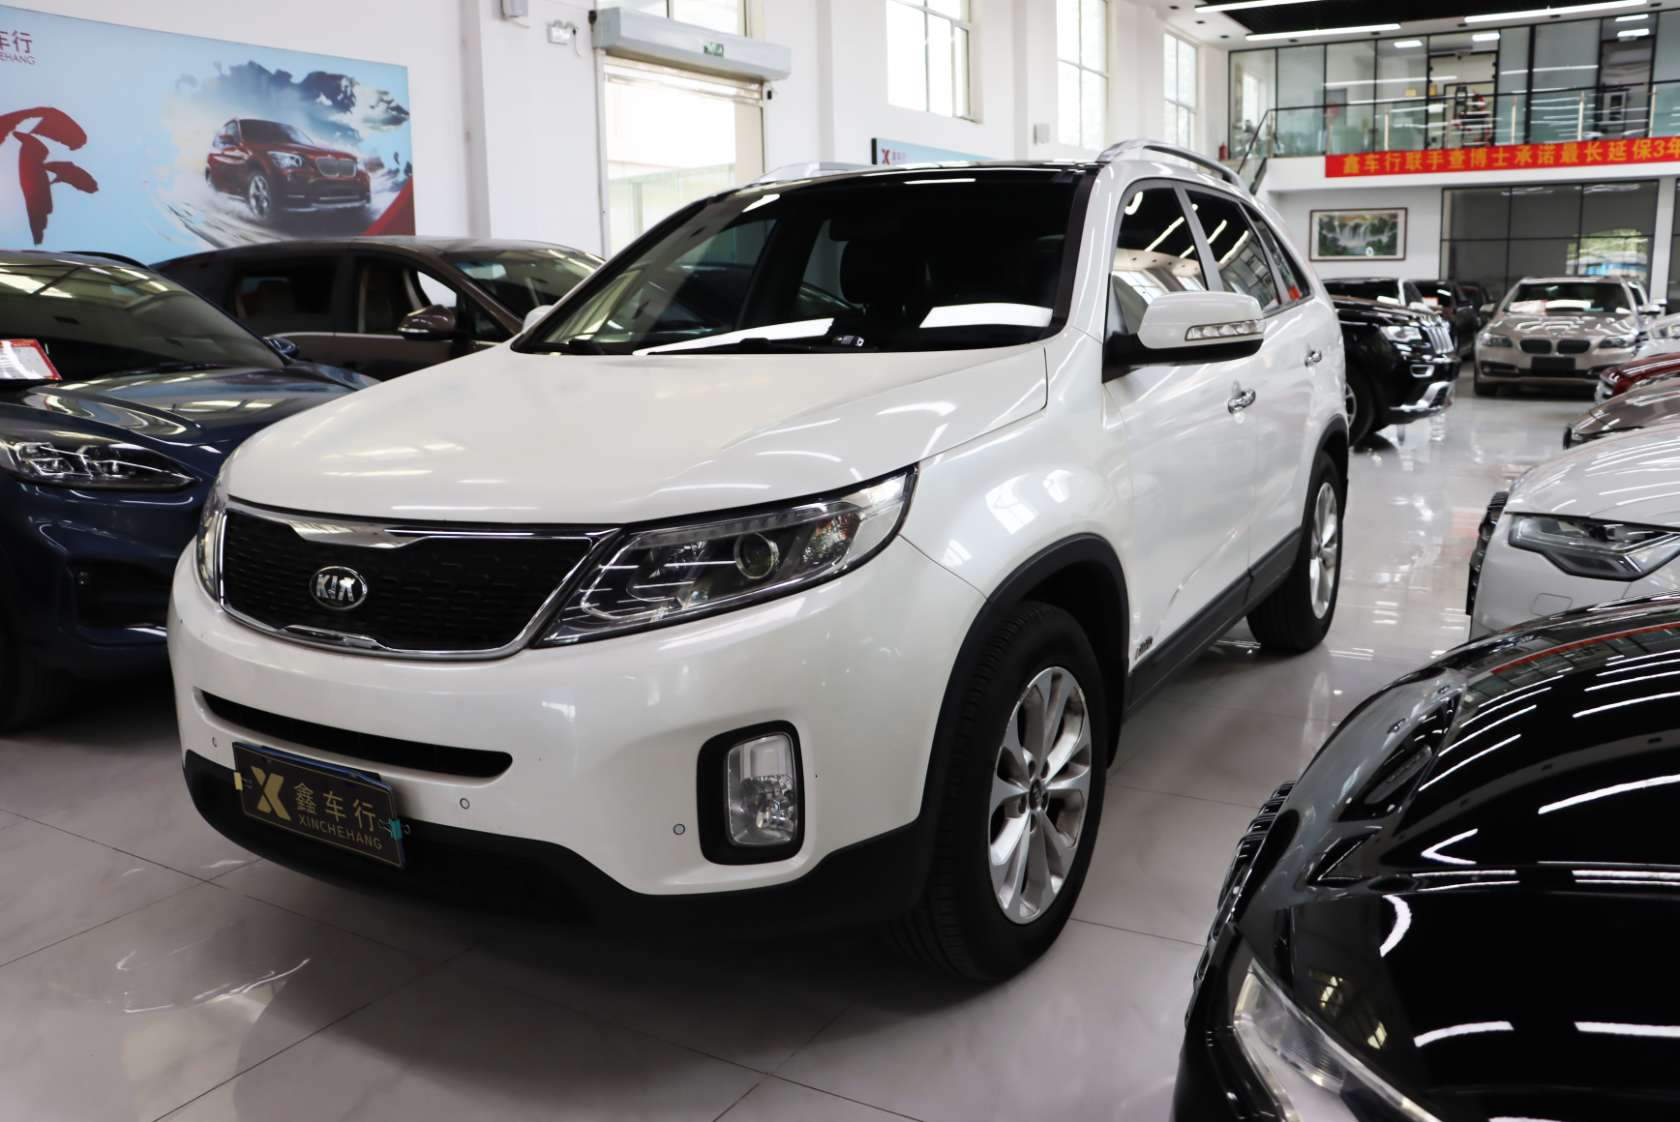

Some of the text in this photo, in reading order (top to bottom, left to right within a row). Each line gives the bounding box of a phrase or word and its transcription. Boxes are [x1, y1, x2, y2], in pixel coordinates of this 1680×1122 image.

[316, 574, 355, 602] KIA
[293, 782, 377, 832] 鑫车行
[299, 814, 383, 850] XINCHEHANG
